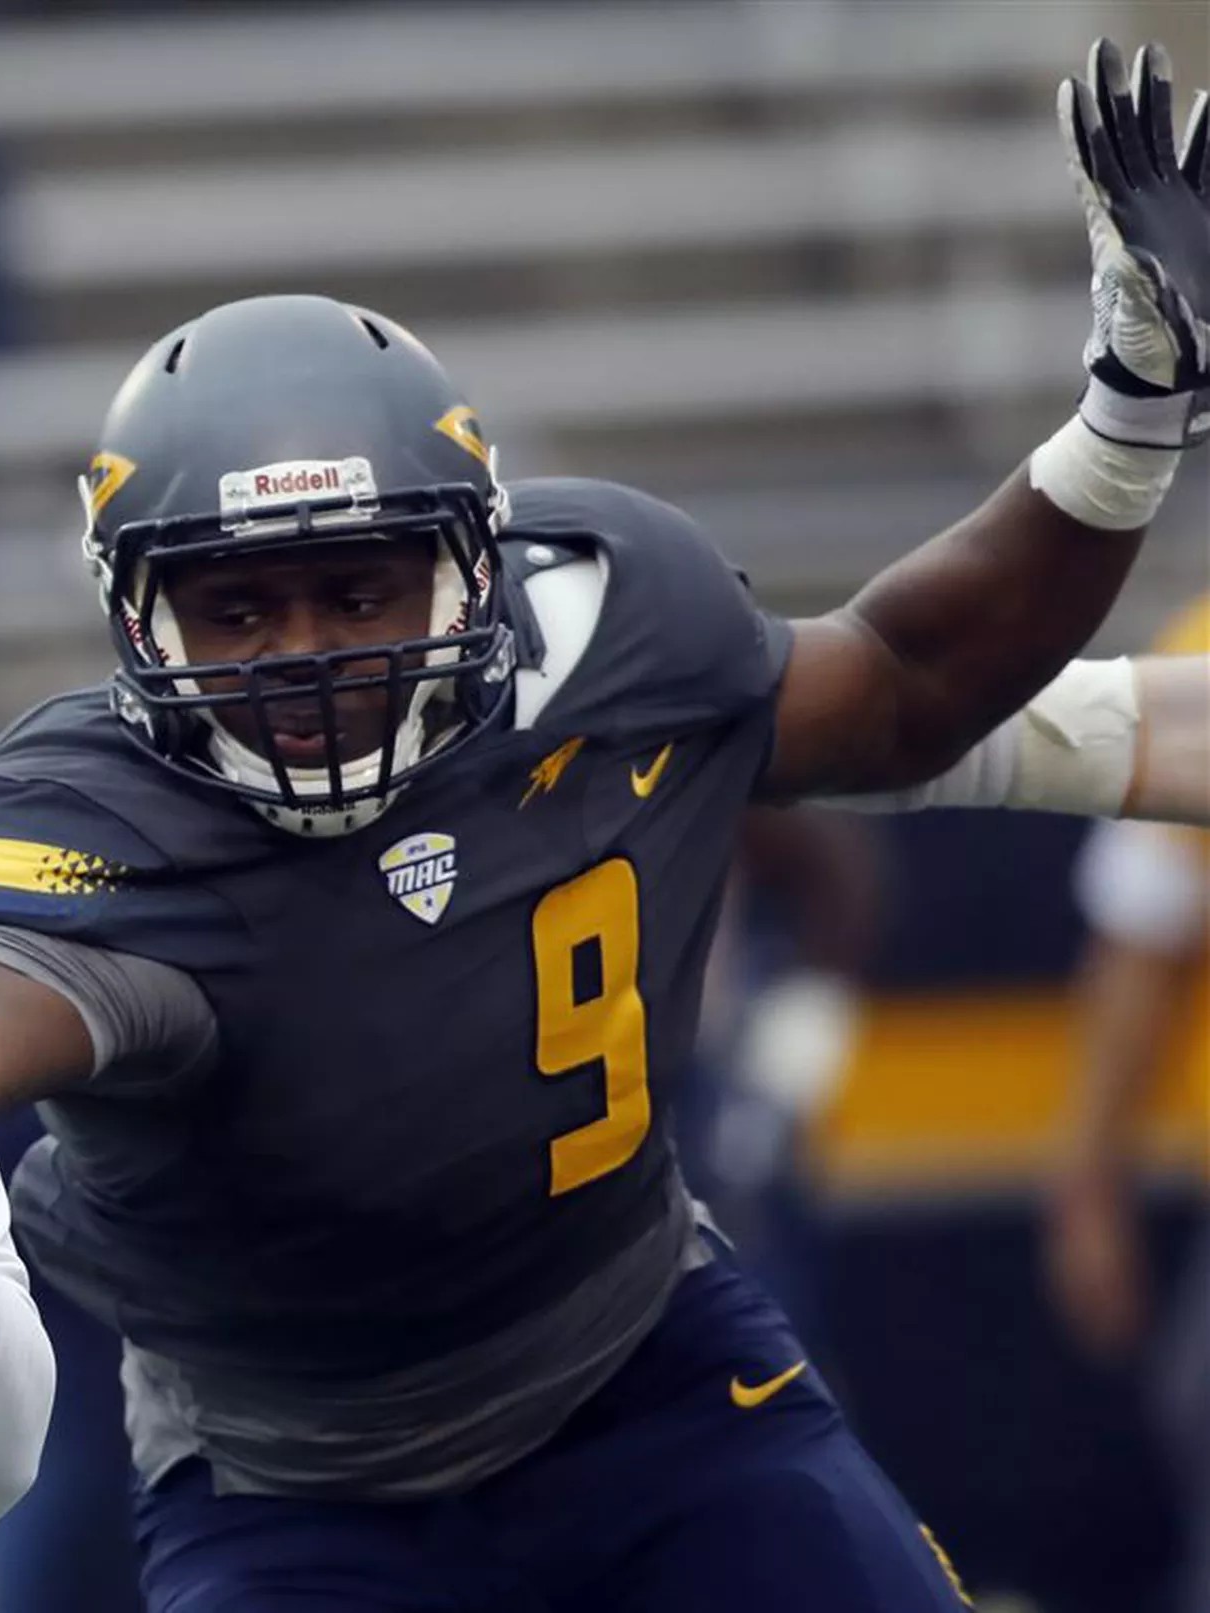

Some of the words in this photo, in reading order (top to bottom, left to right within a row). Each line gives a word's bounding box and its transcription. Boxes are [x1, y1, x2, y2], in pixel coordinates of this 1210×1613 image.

[254, 467, 339, 496] Riddell
[387, 853, 458, 896] MAC
[532, 857, 651, 1197] 9
